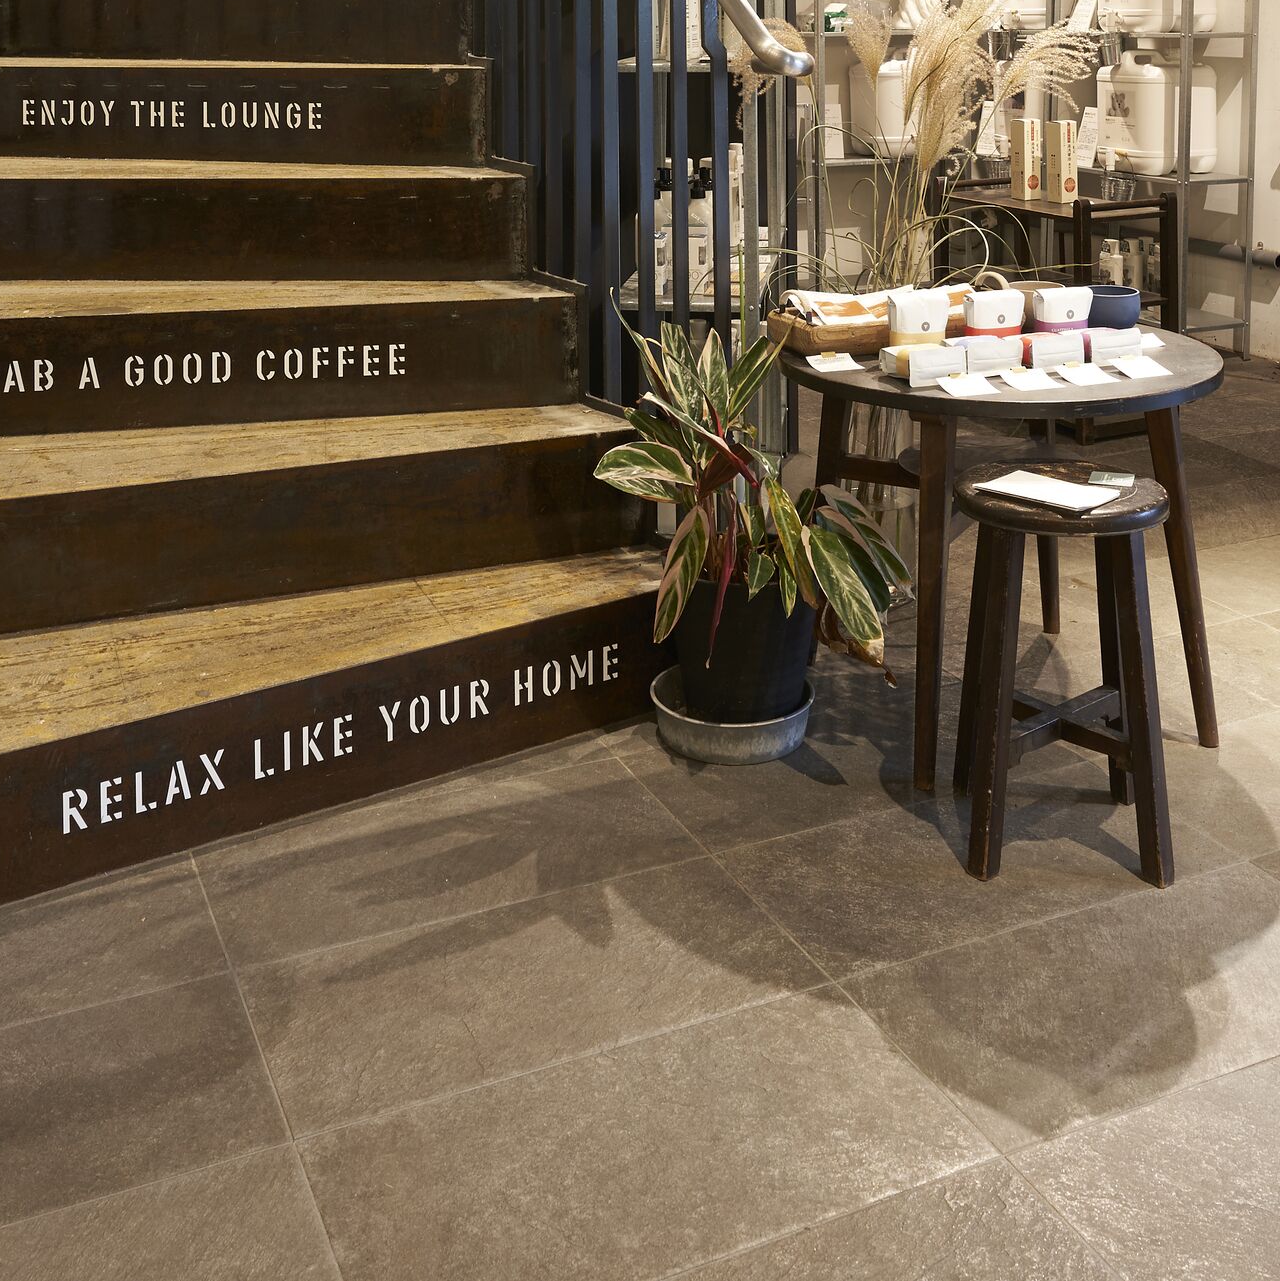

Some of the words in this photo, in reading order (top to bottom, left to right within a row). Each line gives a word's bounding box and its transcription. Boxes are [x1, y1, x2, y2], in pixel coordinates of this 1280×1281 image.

[22, 99, 115, 127] ENJOY
[130, 100, 185, 128] THE
[203, 100, 322, 130] LOUNGE
[78, 357, 101, 390] A
[124, 350, 231, 387] GOOD
[255, 343, 406, 382] COFFEE
[63, 748, 225, 835] RELAX
[254, 713, 353, 780] LIKE
[378, 677, 490, 743] YOUR
[514, 642, 620, 707] HOME
